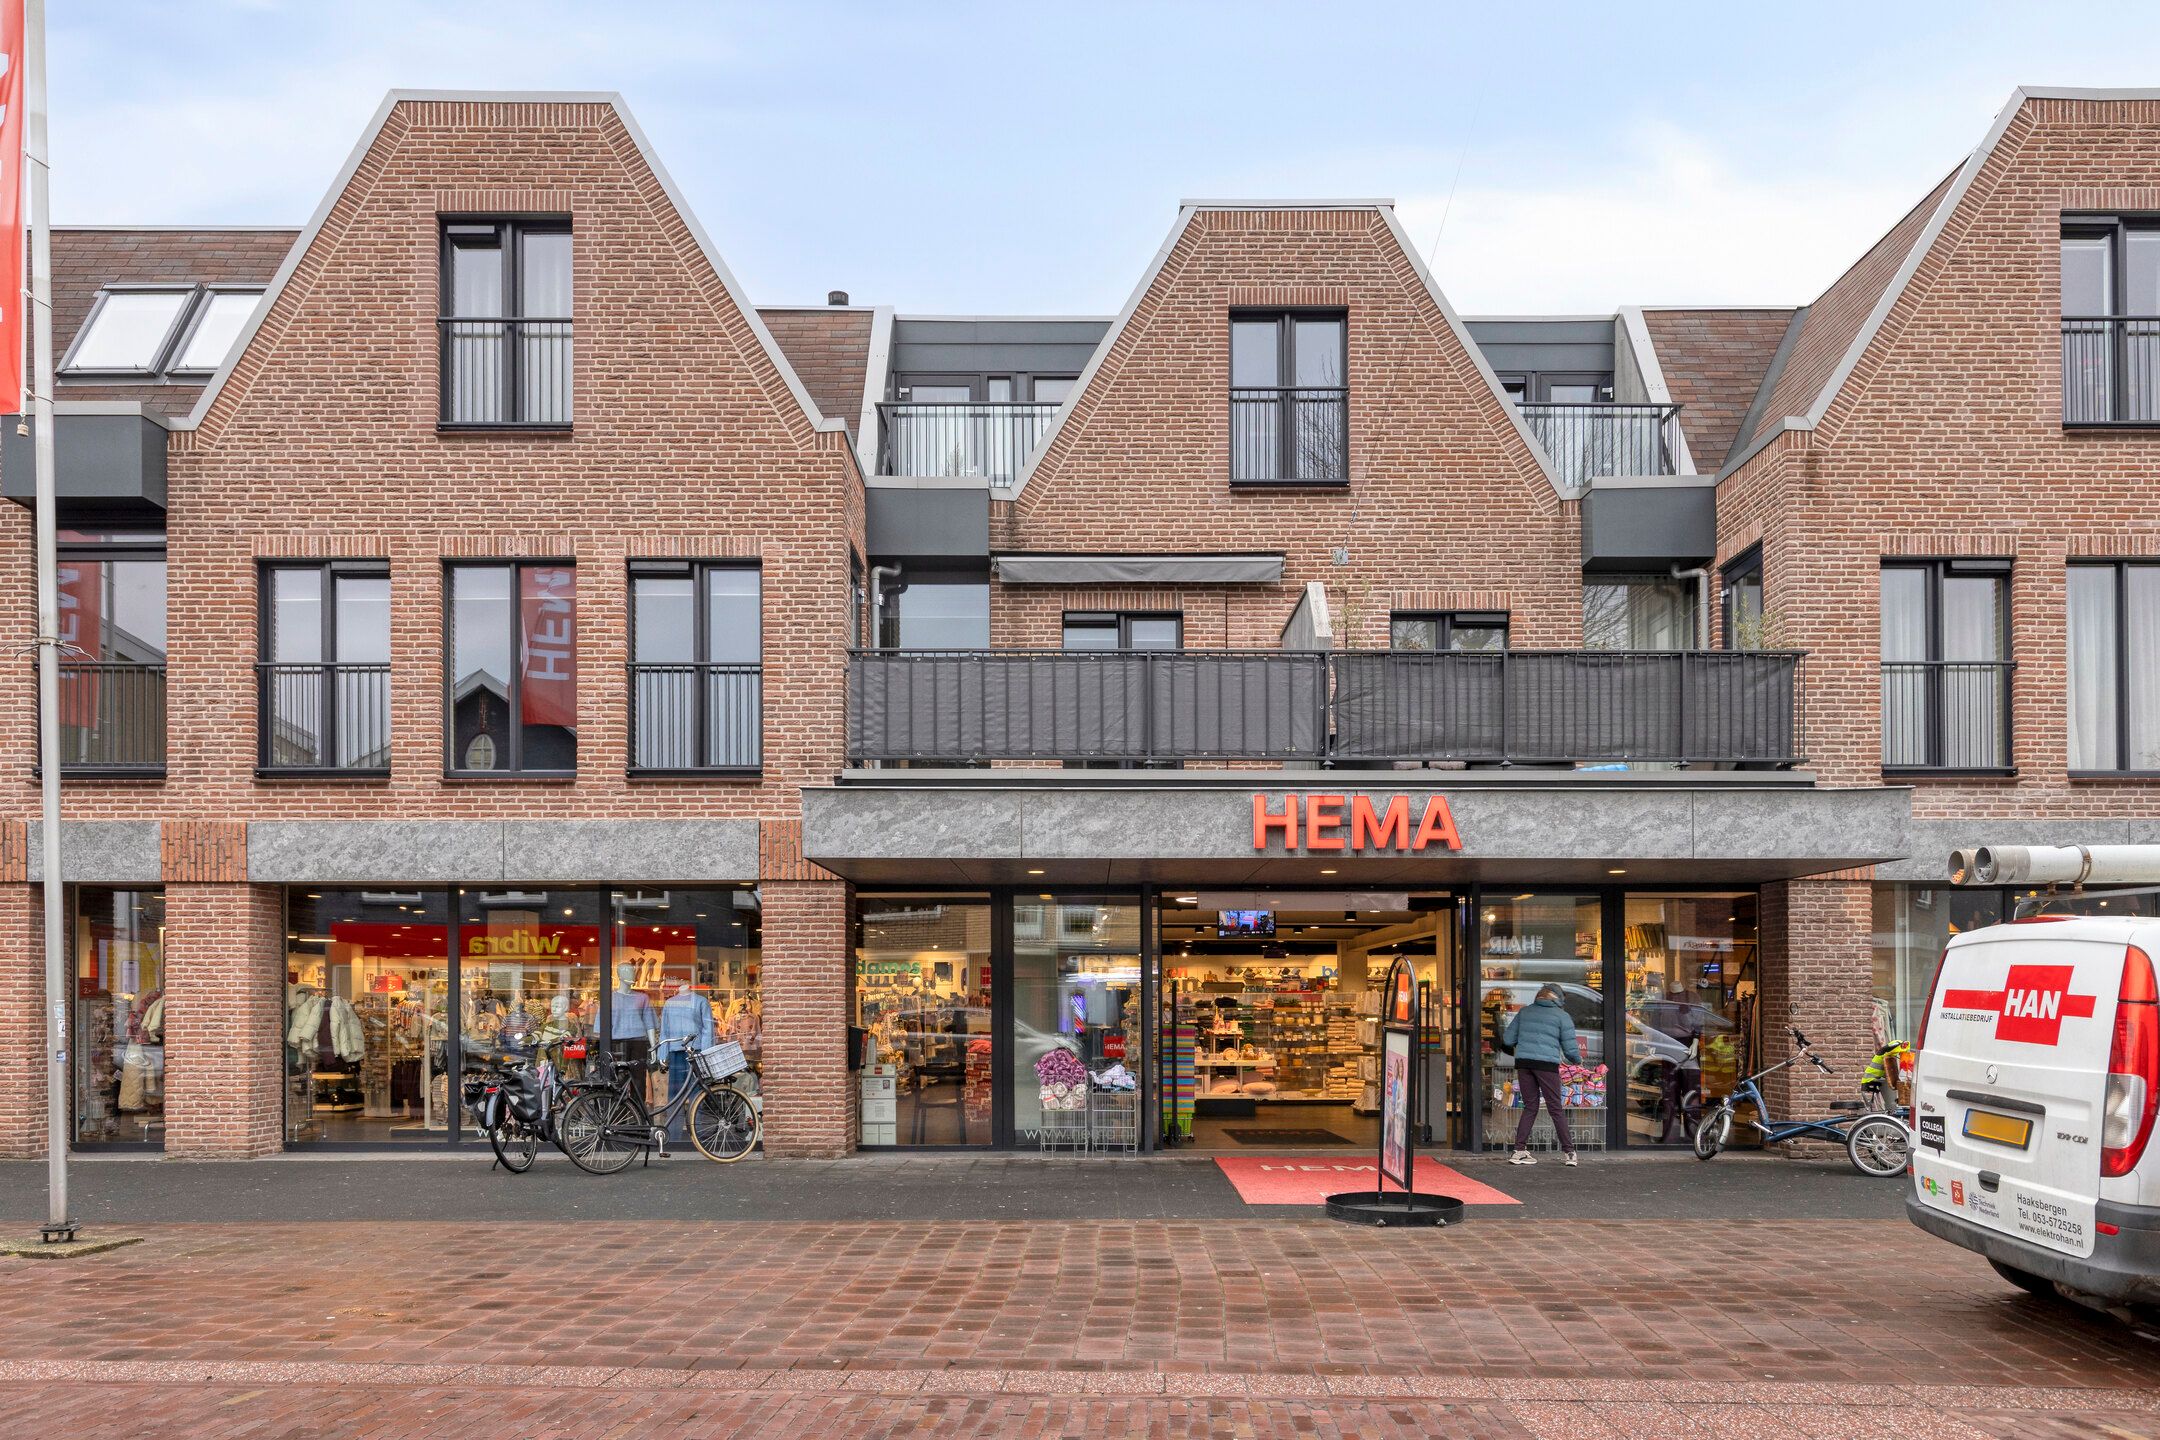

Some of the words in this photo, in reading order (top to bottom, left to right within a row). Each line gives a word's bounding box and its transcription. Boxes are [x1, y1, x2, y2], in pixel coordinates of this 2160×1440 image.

[1253, 794, 1463, 850] HEMA
[2004, 988, 2062, 1020] HAN
[1940, 1012, 1993, 1023] INSTALLATIEBEDRIJF
[1921, 1120, 1944, 1133] COLLEGA
[1921, 1131, 1945, 1145] GEZOCHT!
[2016, 1192, 2067, 1216] Haaksbergen
[2018, 1207, 2031, 1220] Tel.
[2032, 1211, 2082, 1236] 053-5725258
[2018, 1222, 2084, 1249] www.elektrohan.nl
